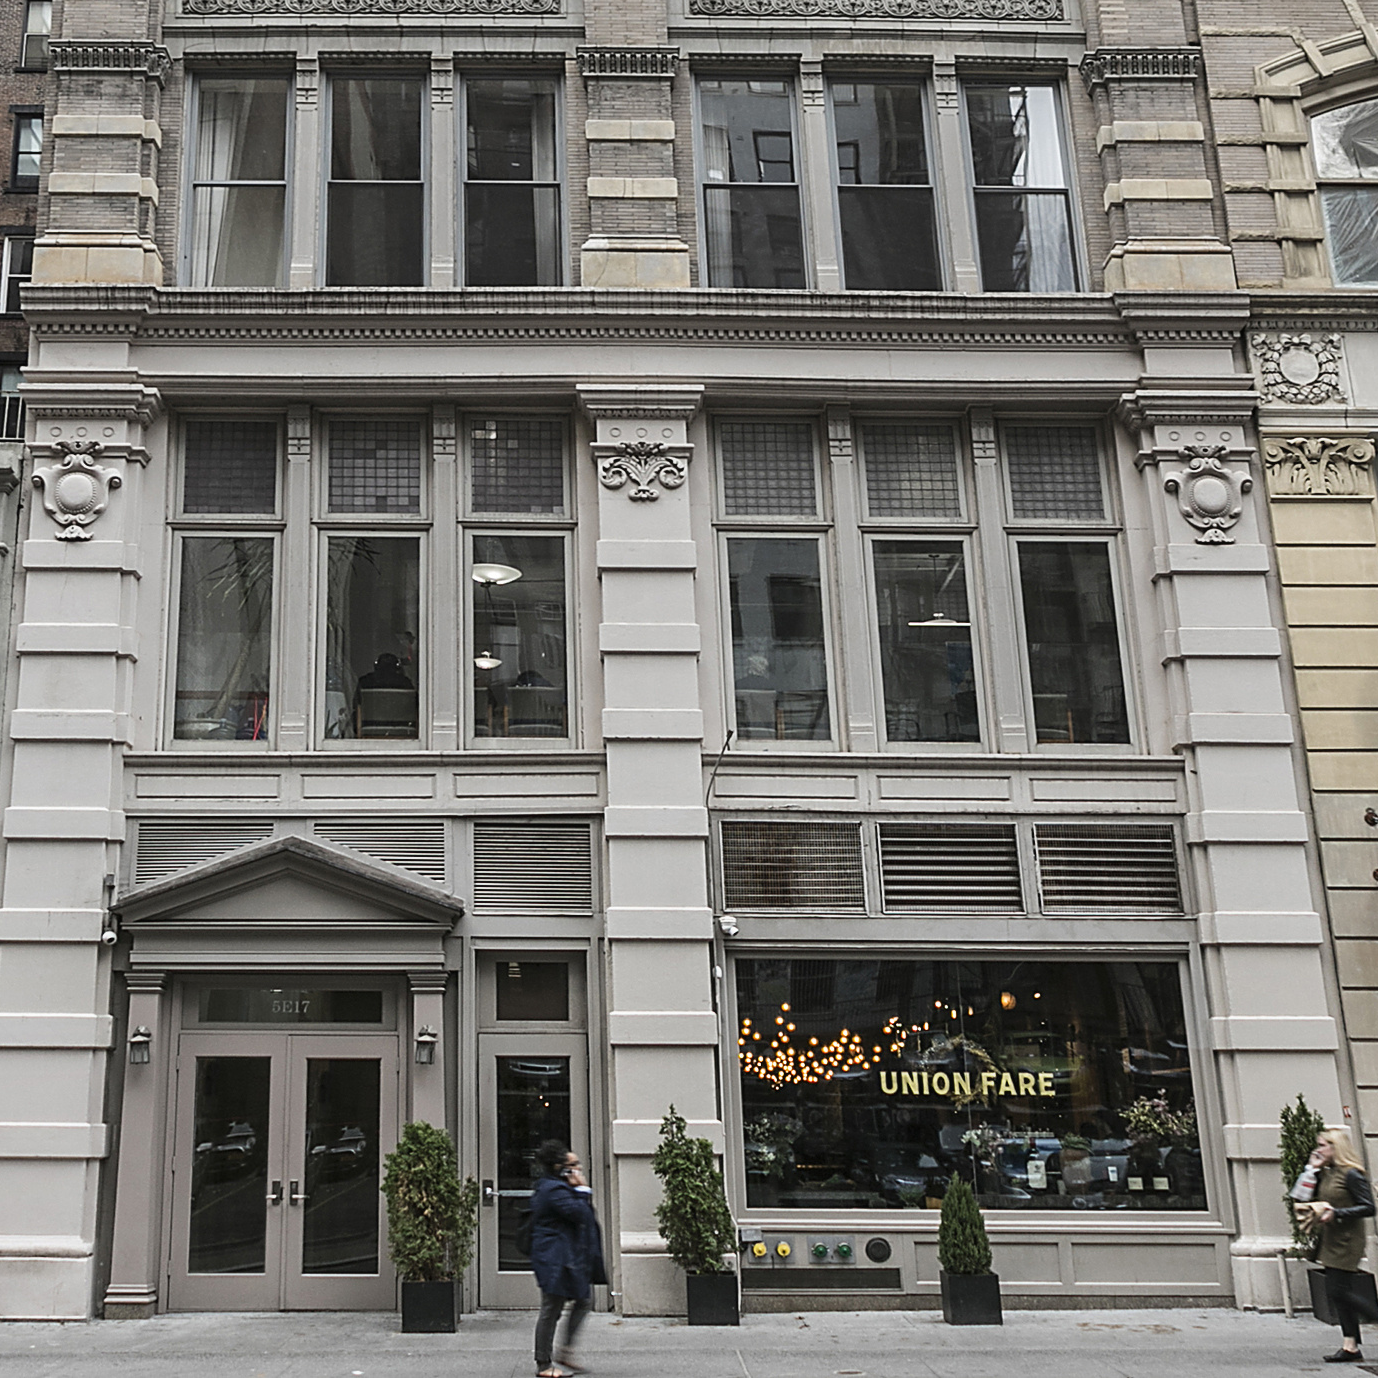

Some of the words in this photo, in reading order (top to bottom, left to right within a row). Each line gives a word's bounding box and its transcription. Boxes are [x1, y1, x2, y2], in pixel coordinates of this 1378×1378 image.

[272, 1000, 310, 1013] 5E17
[880, 1071, 972, 1095] UNION
[981, 1072, 1056, 1096] FARE
